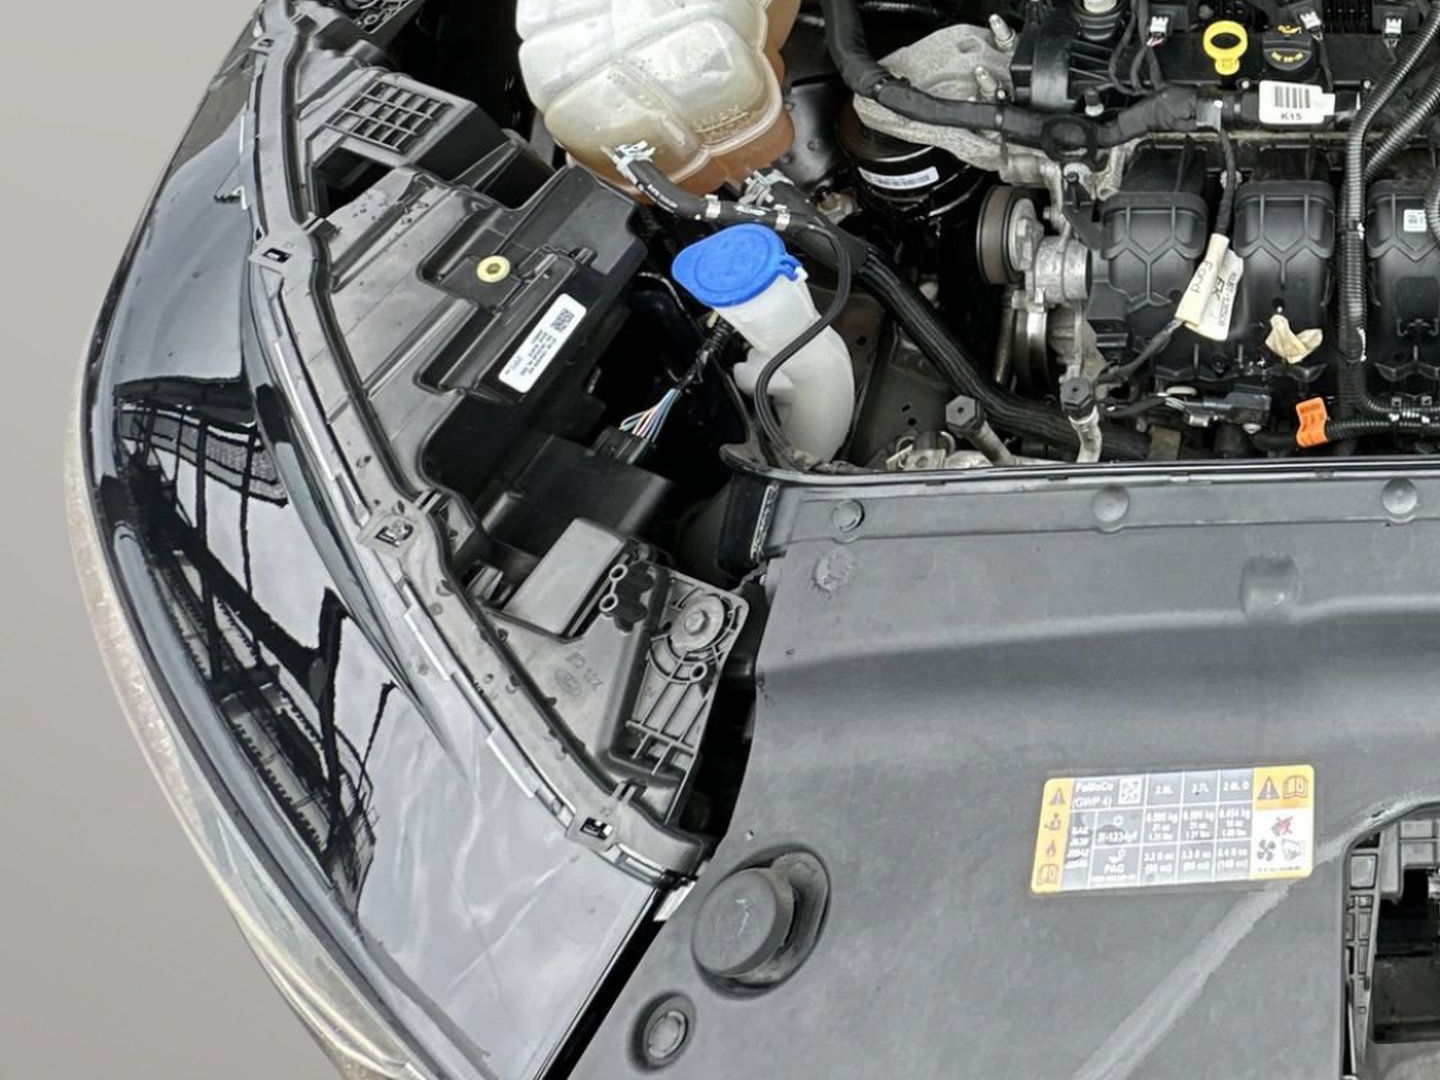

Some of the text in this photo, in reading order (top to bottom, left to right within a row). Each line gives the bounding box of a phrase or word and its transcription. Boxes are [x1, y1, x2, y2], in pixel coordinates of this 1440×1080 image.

[1281, 112, 1303, 121] K15
[1189, 260, 1213, 294] Ford
[1075, 781, 1114, 793] FoMoCo
[1104, 863, 1125, 874] PAG
